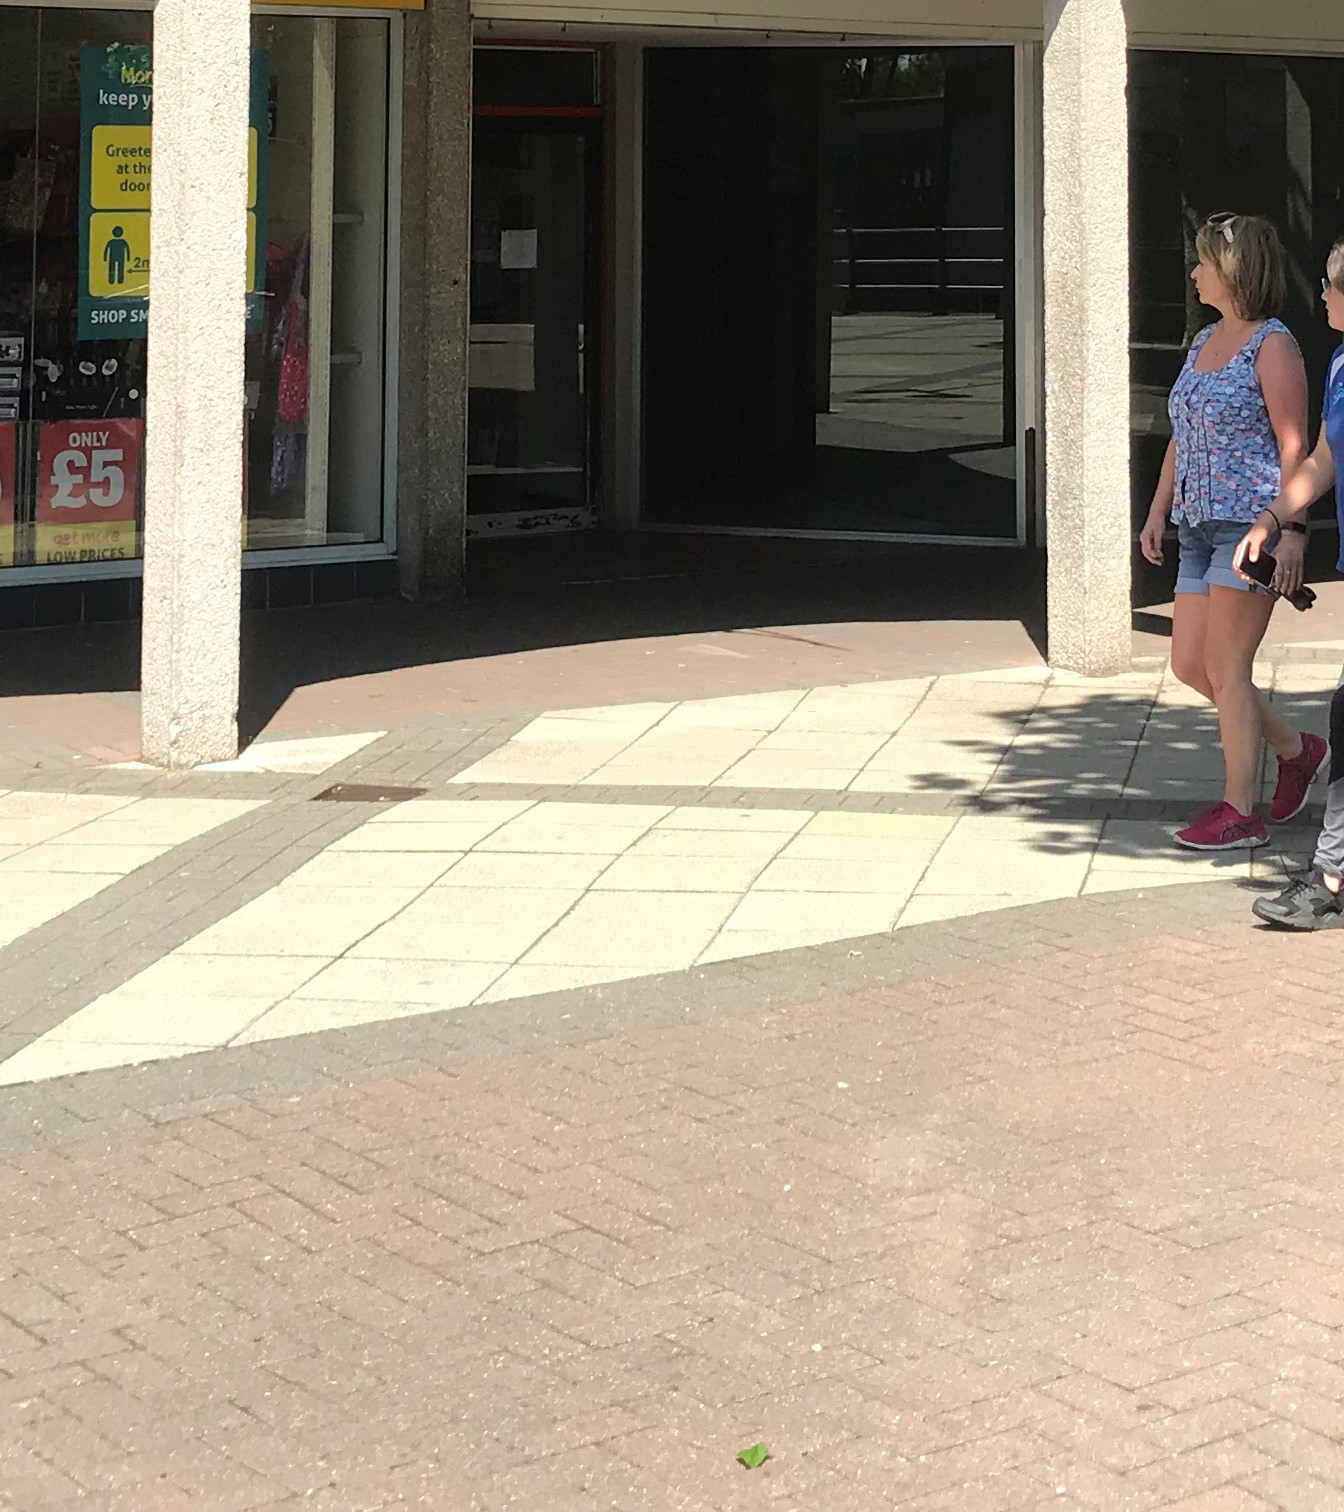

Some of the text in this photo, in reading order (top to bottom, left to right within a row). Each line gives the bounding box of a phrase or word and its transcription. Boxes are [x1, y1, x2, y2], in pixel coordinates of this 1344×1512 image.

[121, 66, 153, 84] Mor
[99, 89, 139, 110] keep
[106, 144, 151, 158] Greete
[116, 163, 130, 175] at
[90, 309, 128, 324] SHOP
[68, 431, 110, 448] ONLY
[50, 448, 125, 509] £5
[53, 529, 121, 546] get more
[46, 547, 125, 564] LOW PRICES
